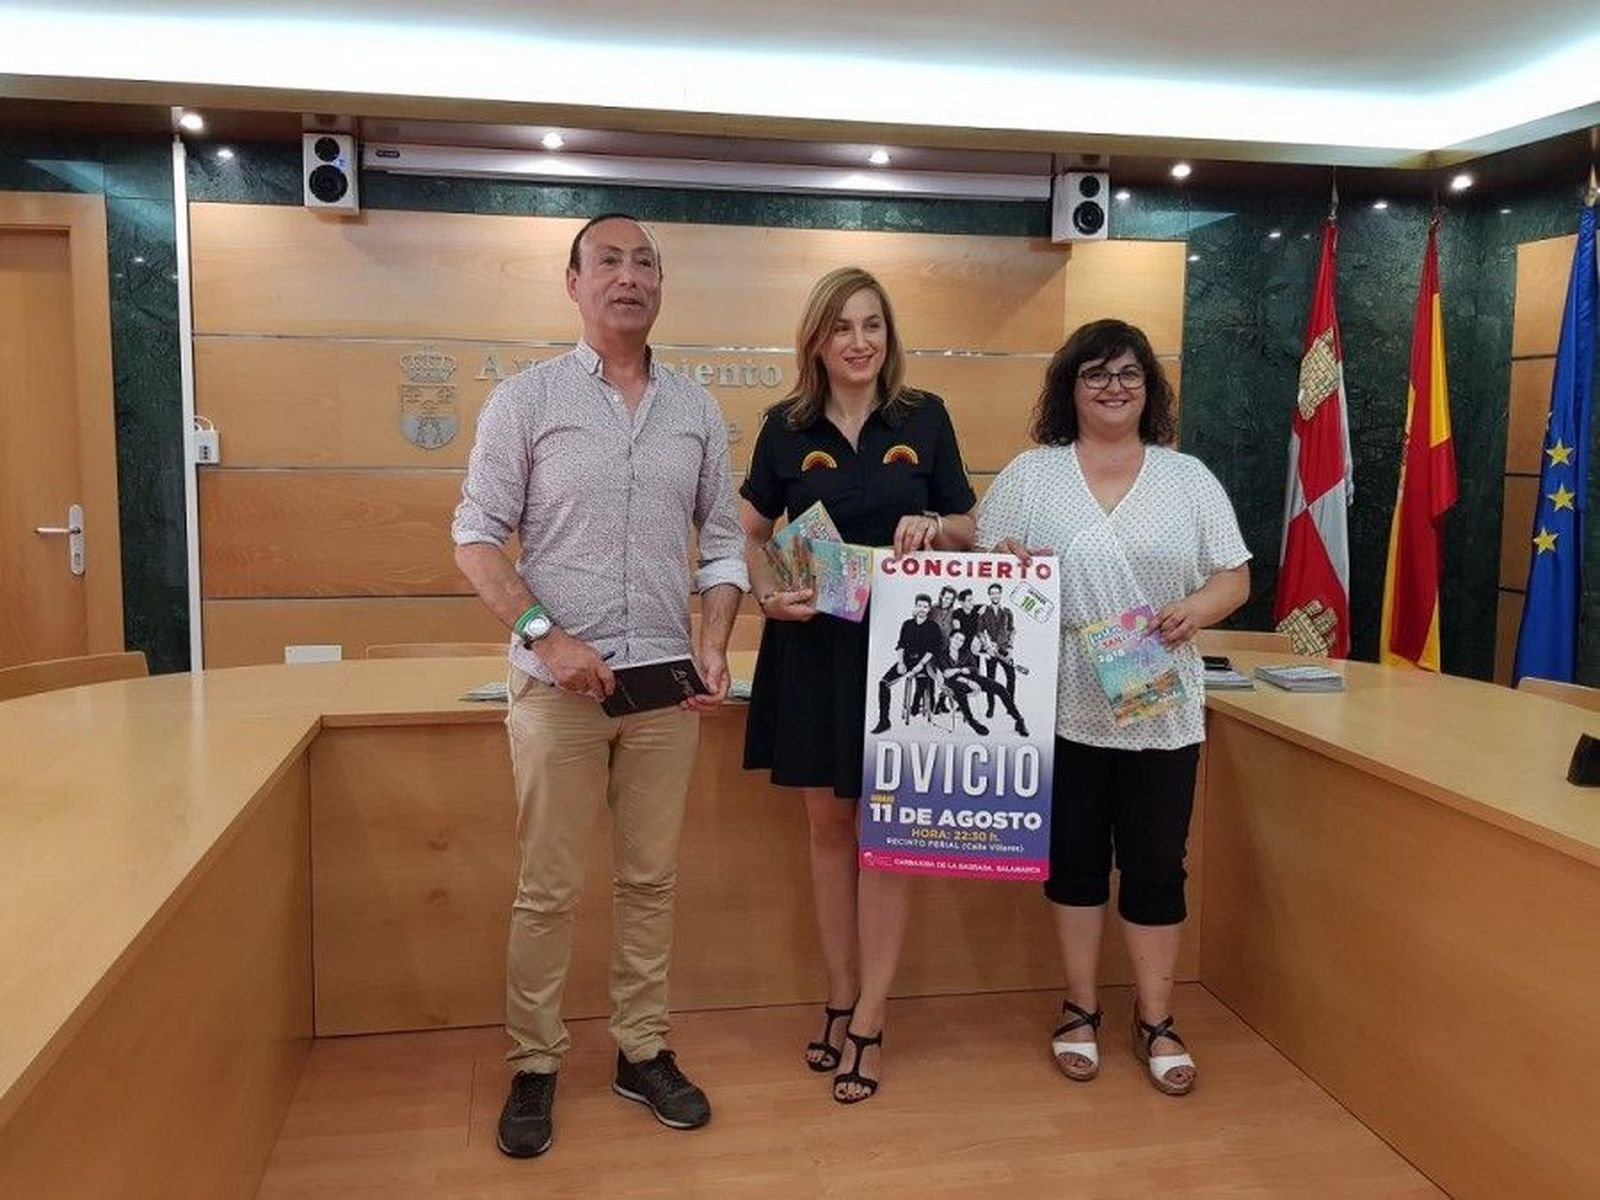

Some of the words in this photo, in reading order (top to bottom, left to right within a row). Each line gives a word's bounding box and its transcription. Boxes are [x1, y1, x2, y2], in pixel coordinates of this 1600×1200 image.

[881, 557, 1052, 580] CONCIERTO
[875, 740, 1039, 797] DVICIO
[869, 803, 892, 822] 11
[899, 807, 932, 825] DE
[937, 809, 1042, 830] AGOSTO
[887, 837, 926, 847] RECINTO
[911, 828, 951, 839] HORA:
[954, 831, 986, 841] 22:30
